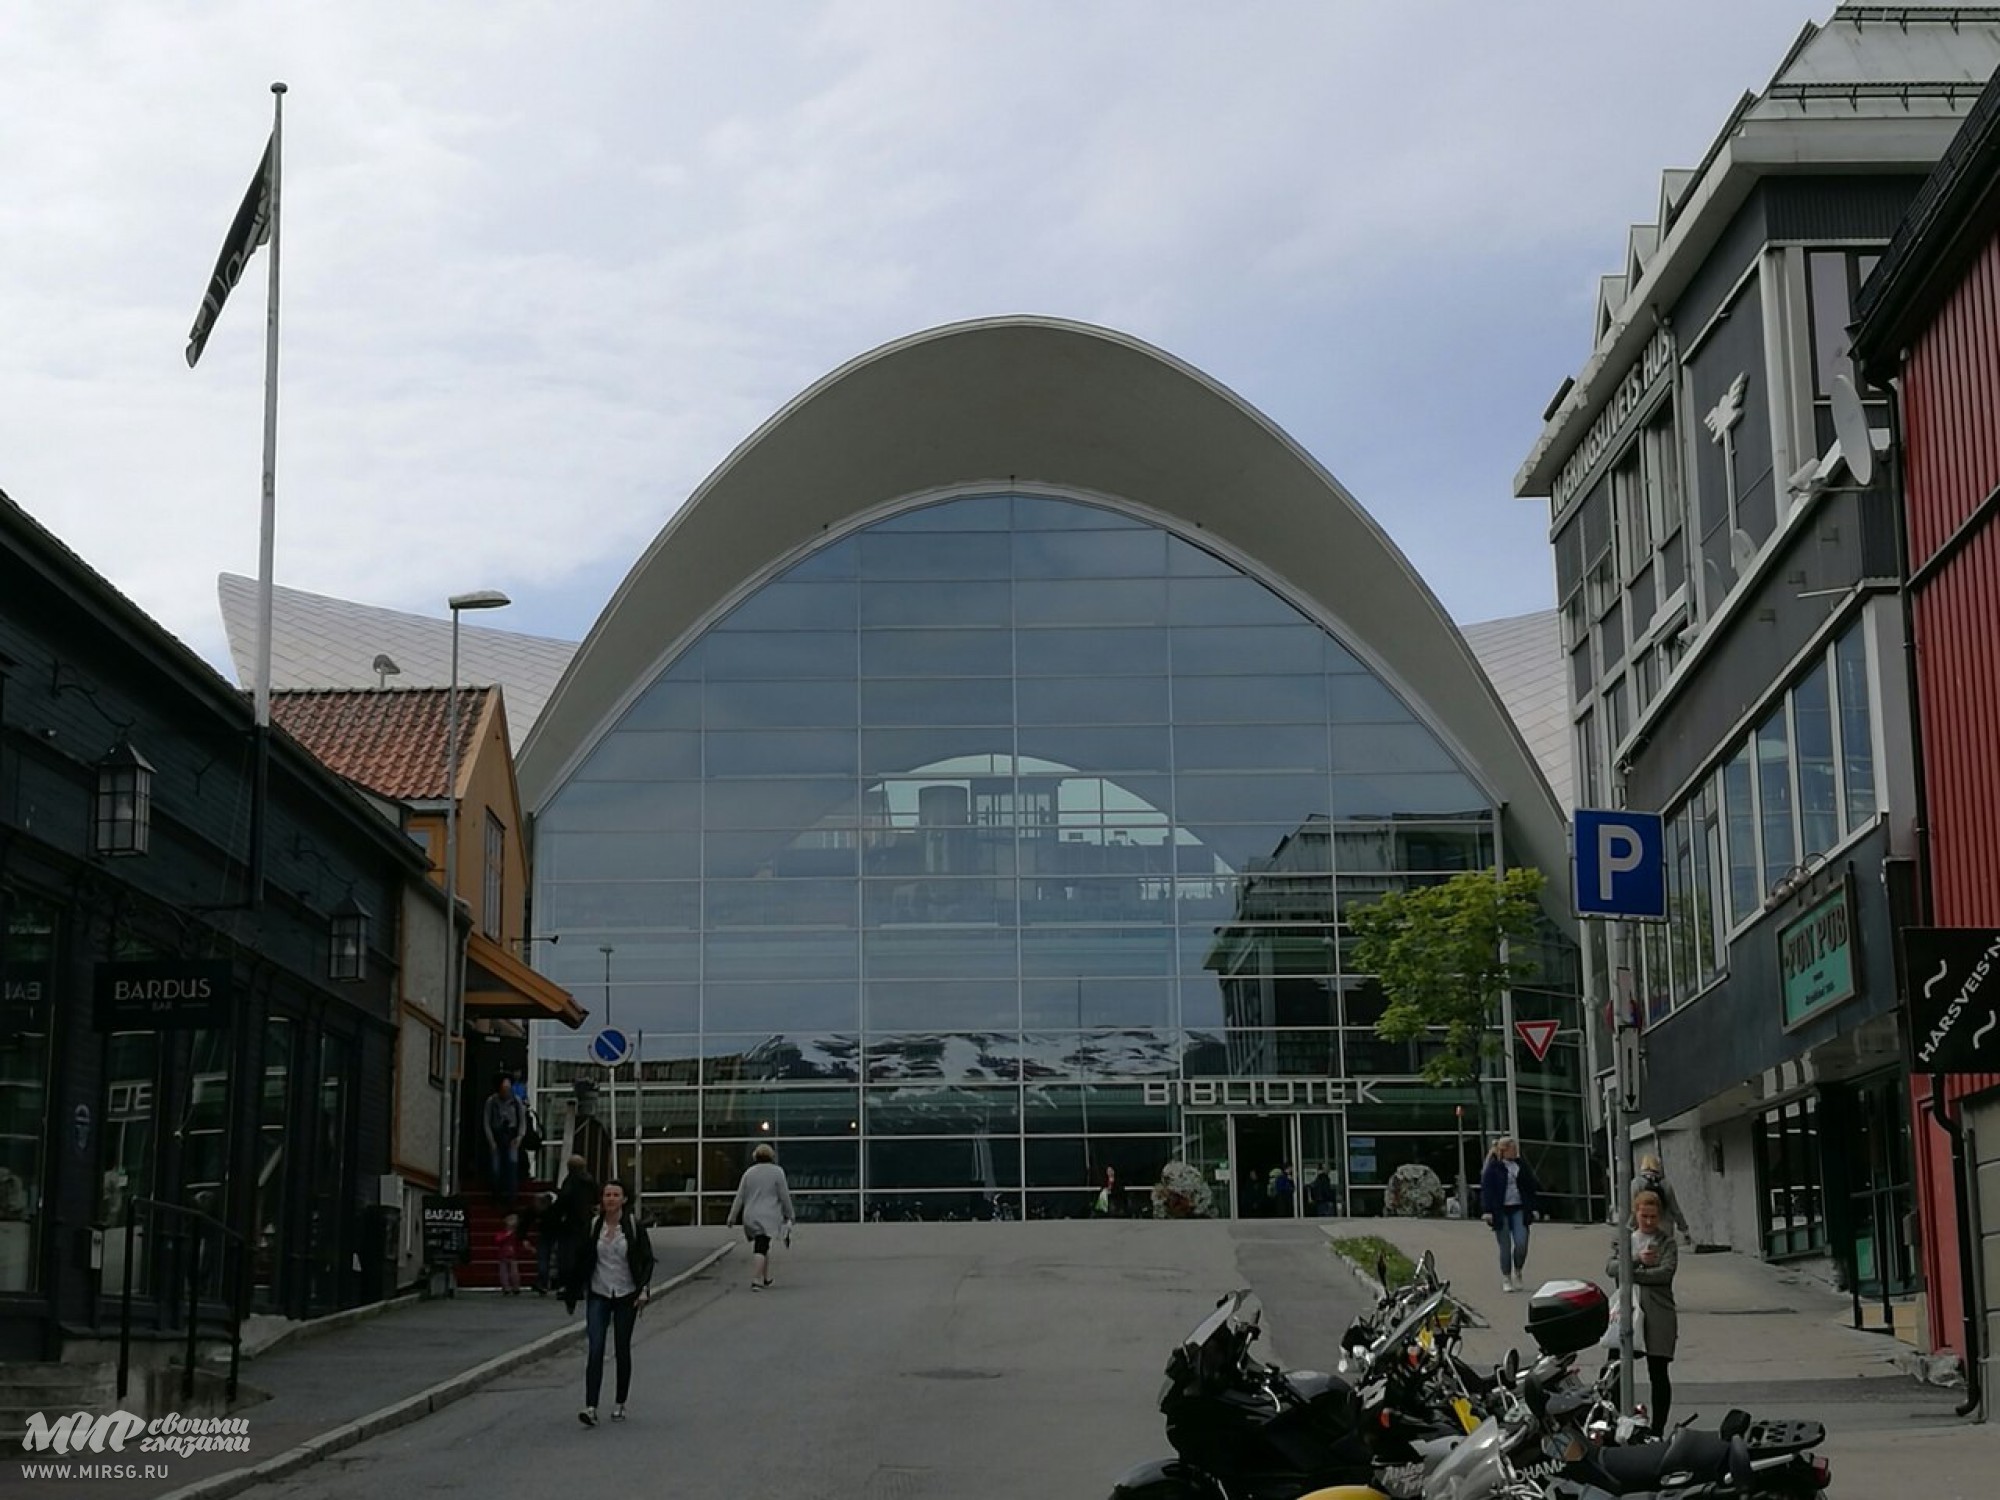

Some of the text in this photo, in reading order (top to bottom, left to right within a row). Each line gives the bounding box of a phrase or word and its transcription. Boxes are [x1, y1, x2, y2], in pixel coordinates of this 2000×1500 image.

[1598, 824, 1643, 901] P
[1817, 906, 1847, 959] PUB
[114, 977, 212, 1001] BARDUS
[1143, 1079, 1383, 1106] BIBLIOTEK
